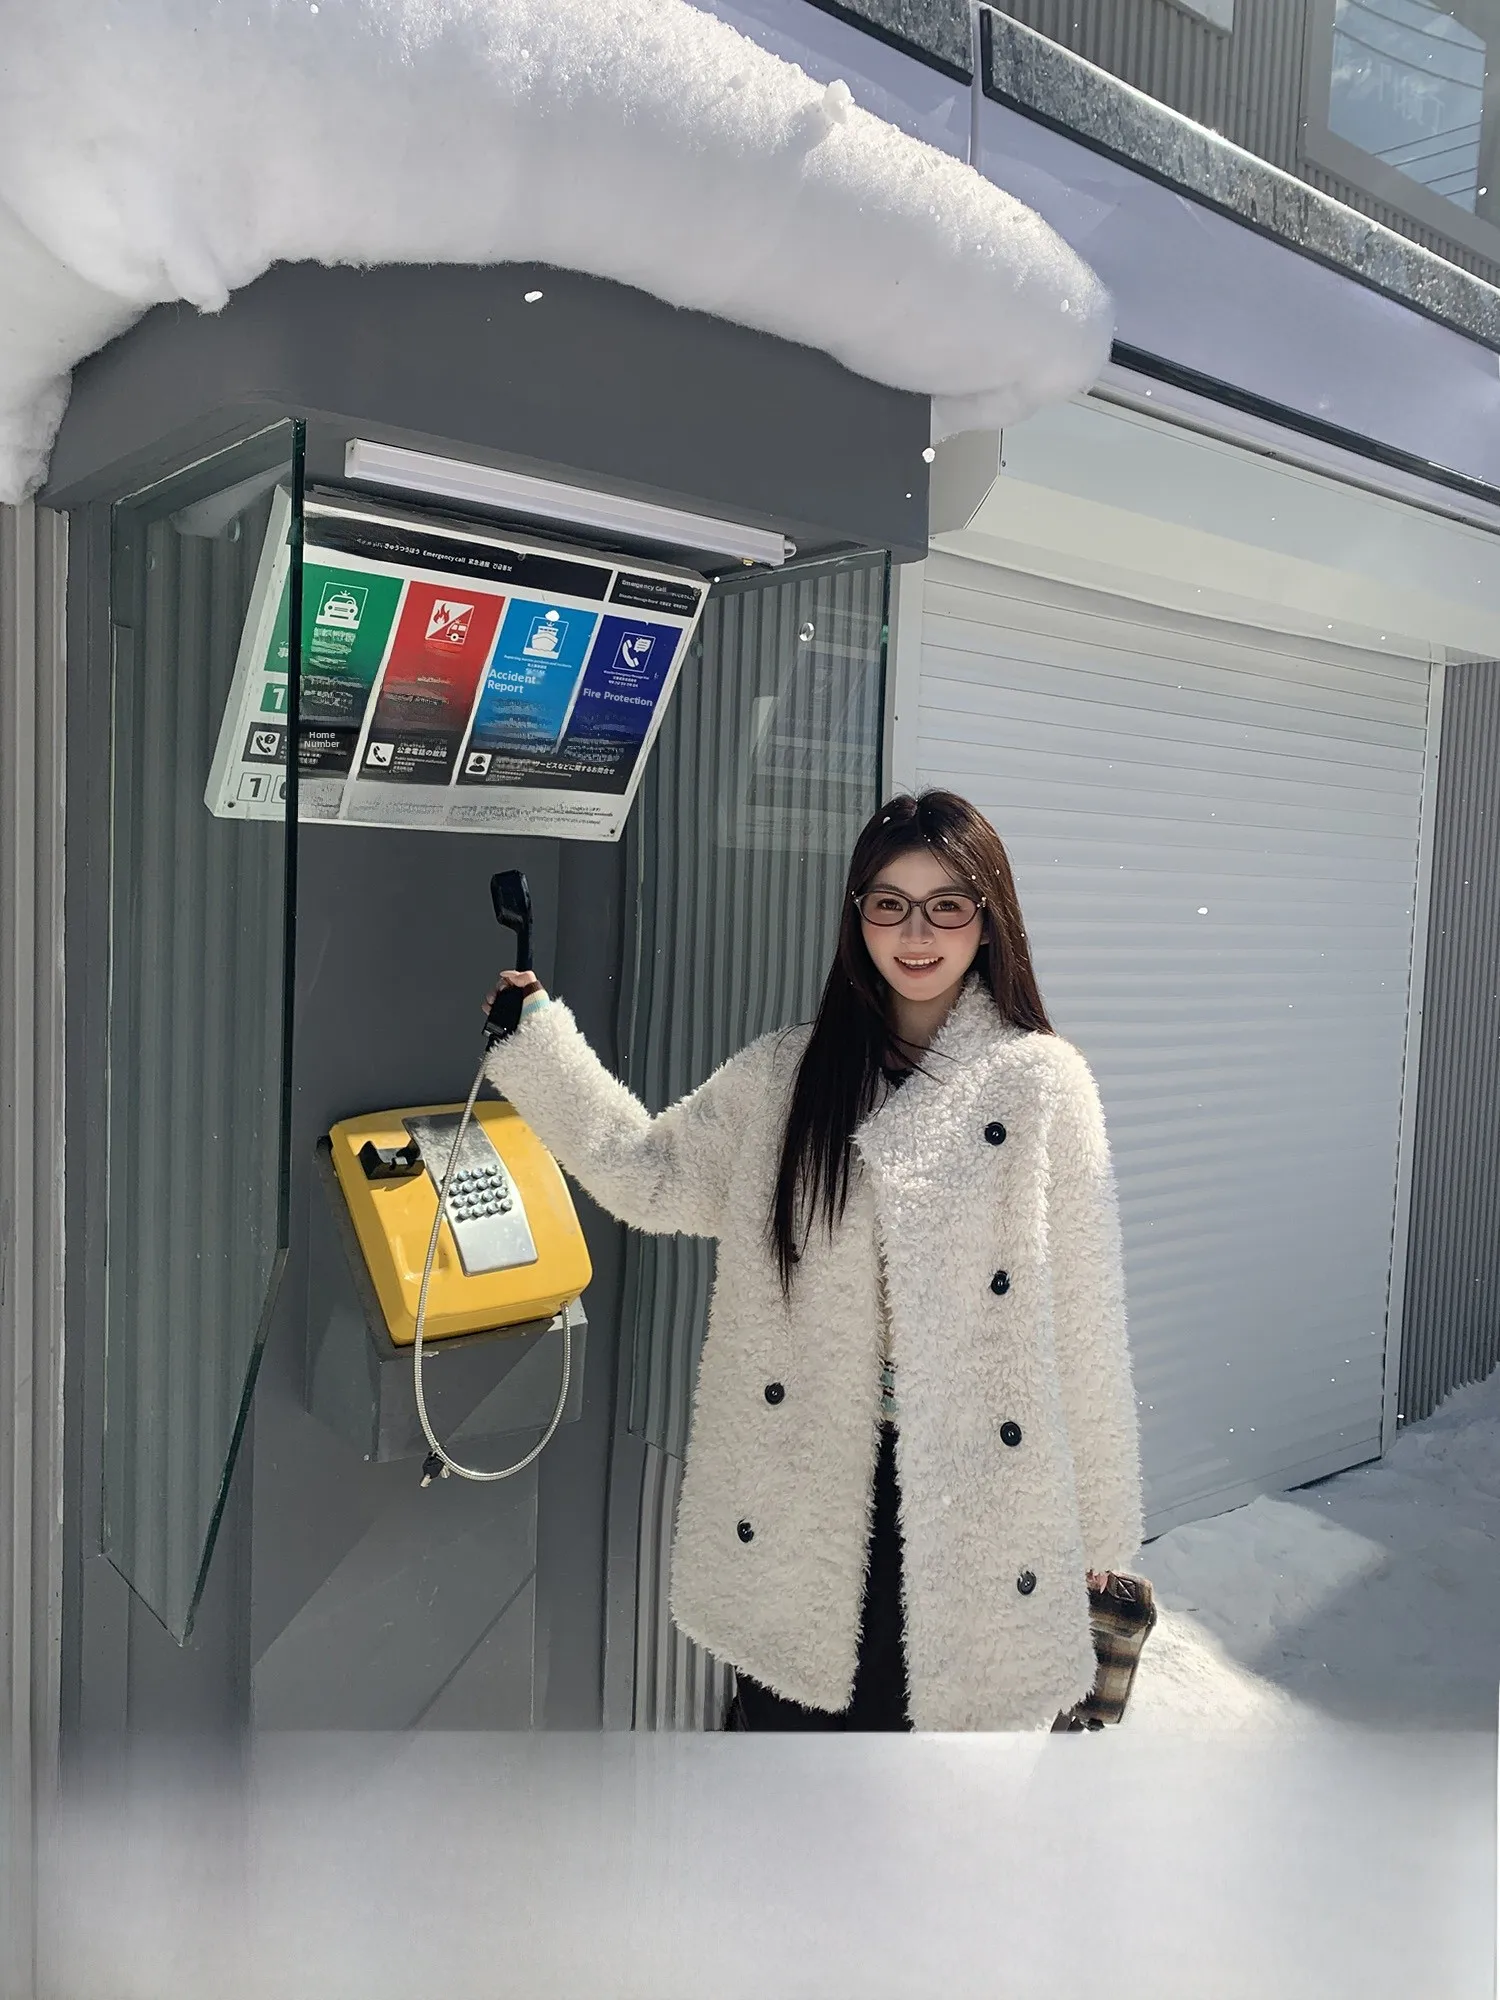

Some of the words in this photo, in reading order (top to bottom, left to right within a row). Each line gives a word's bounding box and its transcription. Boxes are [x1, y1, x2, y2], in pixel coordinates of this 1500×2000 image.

[422, 550, 456, 563] Emergency
[455, 556, 466, 564] call
[621, 579, 655, 592] Emergency
[655, 585, 667, 593] Call
[489, 668, 537, 685] Accident
[487, 679, 524, 693] Report
[583, 687, 602, 699] Fire
[603, 691, 653, 707] Protection
[309, 731, 336, 739] Home
[304, 740, 340, 749] Number
